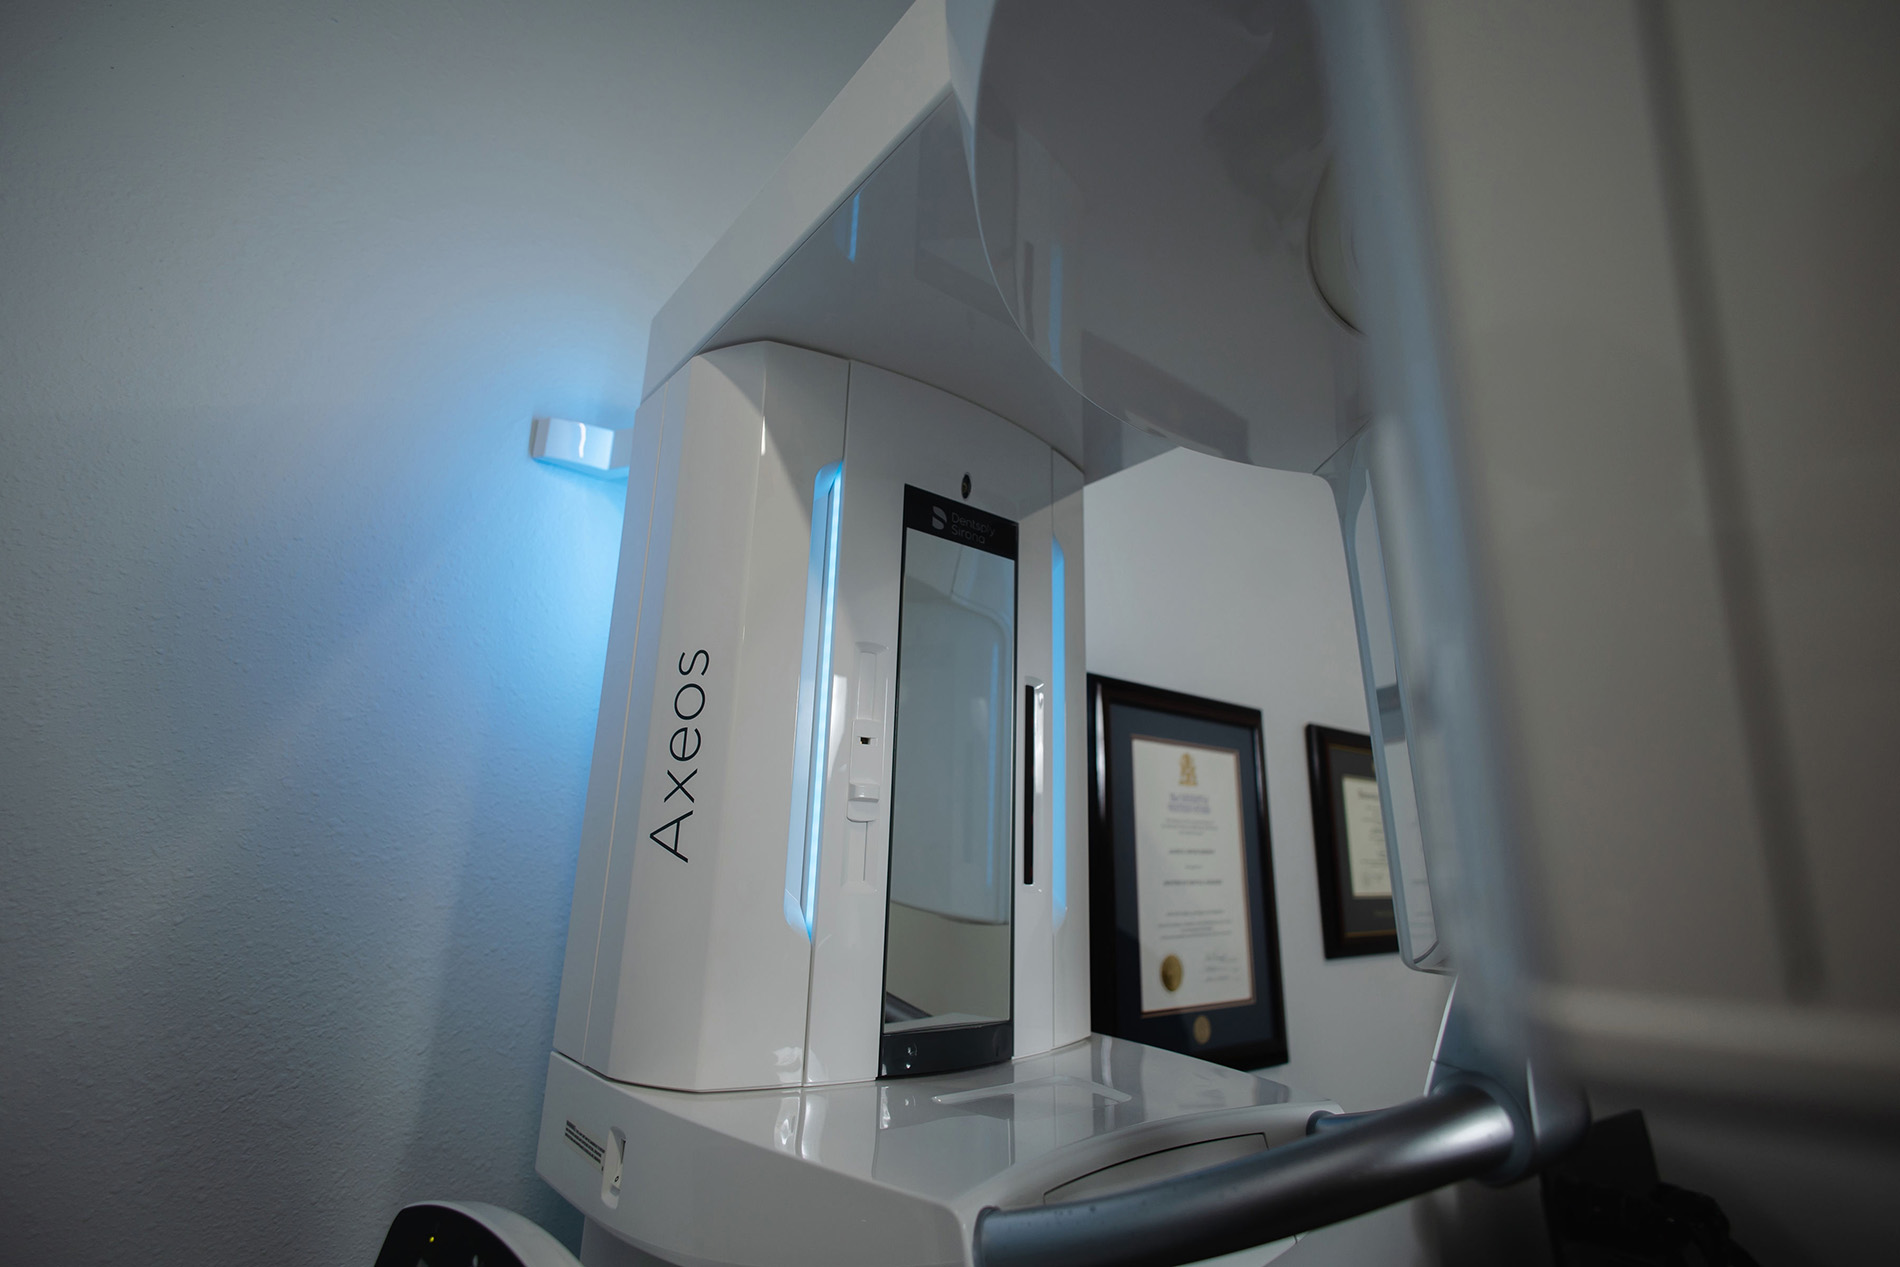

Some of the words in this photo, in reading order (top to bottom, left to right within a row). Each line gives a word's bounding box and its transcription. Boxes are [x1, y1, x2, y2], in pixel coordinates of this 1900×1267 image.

[951, 512, 995, 537] Dentsply
[951, 524, 985, 544] Sirona
[650, 649, 709, 863] Axeos
